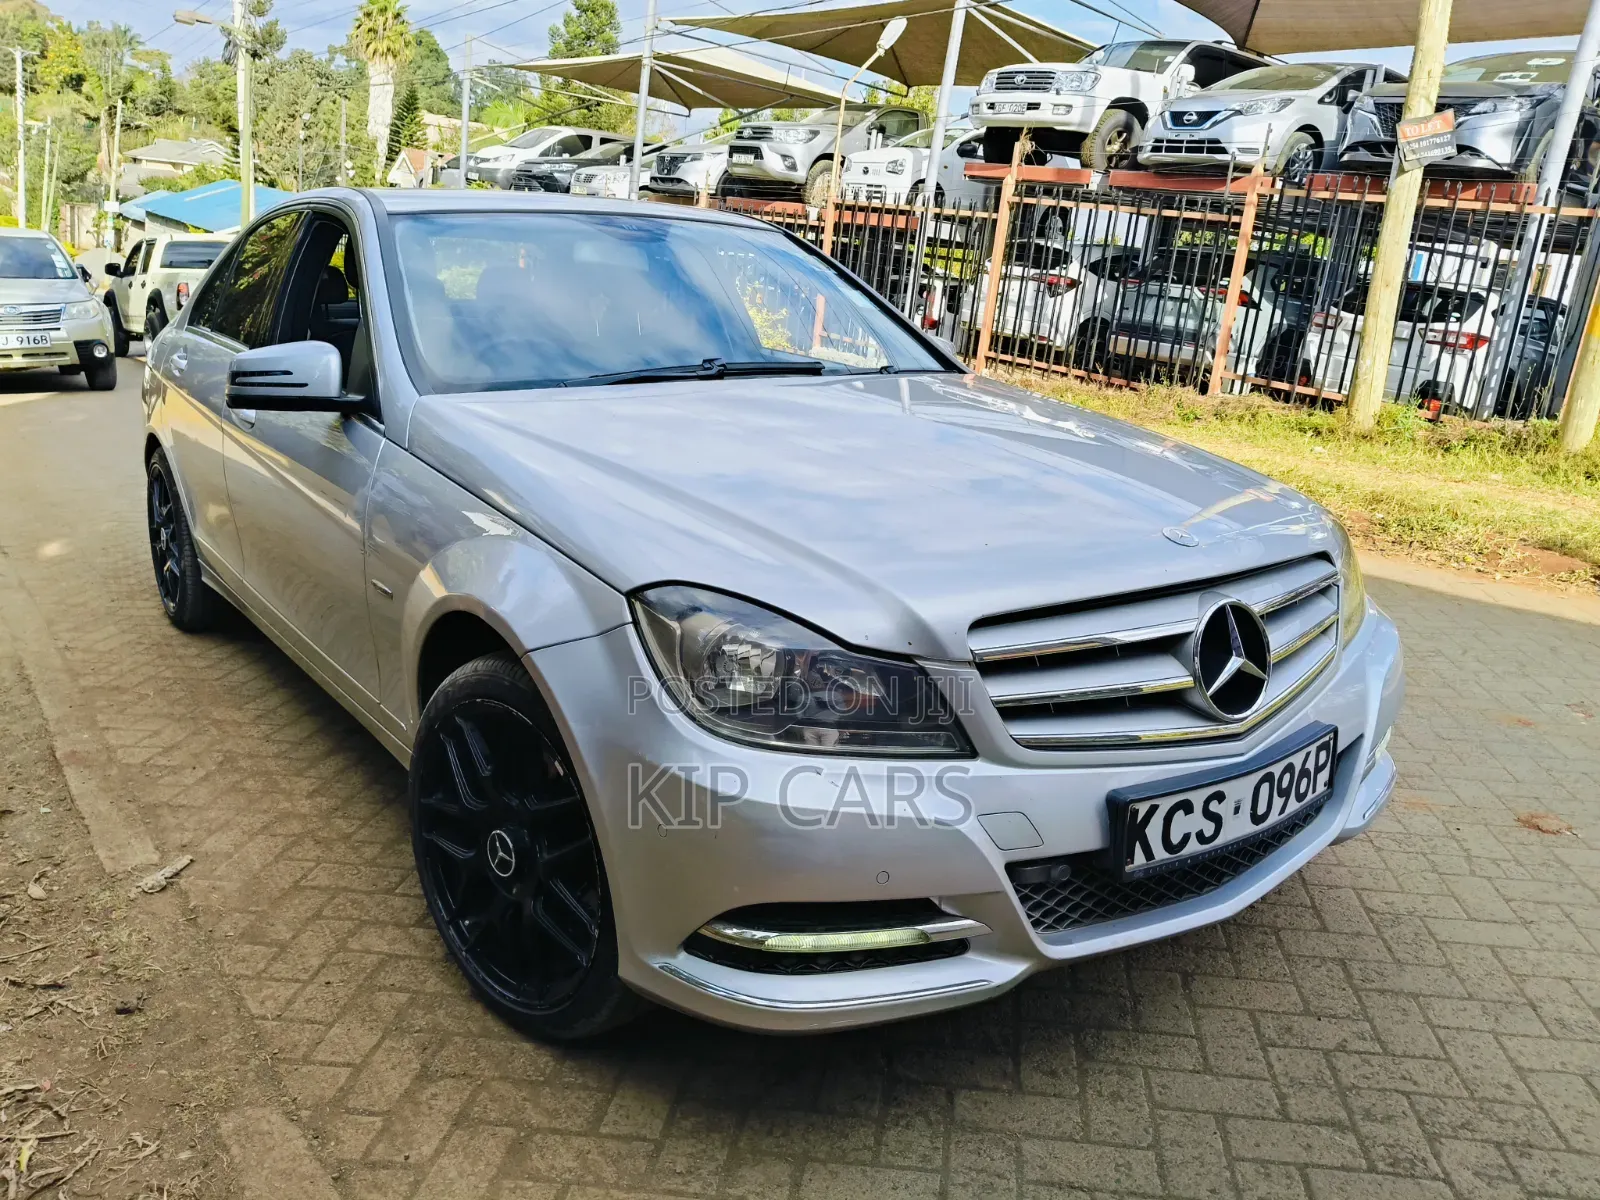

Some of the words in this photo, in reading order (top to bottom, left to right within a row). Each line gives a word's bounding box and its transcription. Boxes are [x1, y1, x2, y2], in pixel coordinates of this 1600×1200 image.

[1405, 125, 1419, 137] TO
[1420, 120, 1442, 134] LET
[16, 335, 48, 346] 916B
[1126, 789, 1226, 866] KCS
[1250, 740, 1332, 827] 096P
